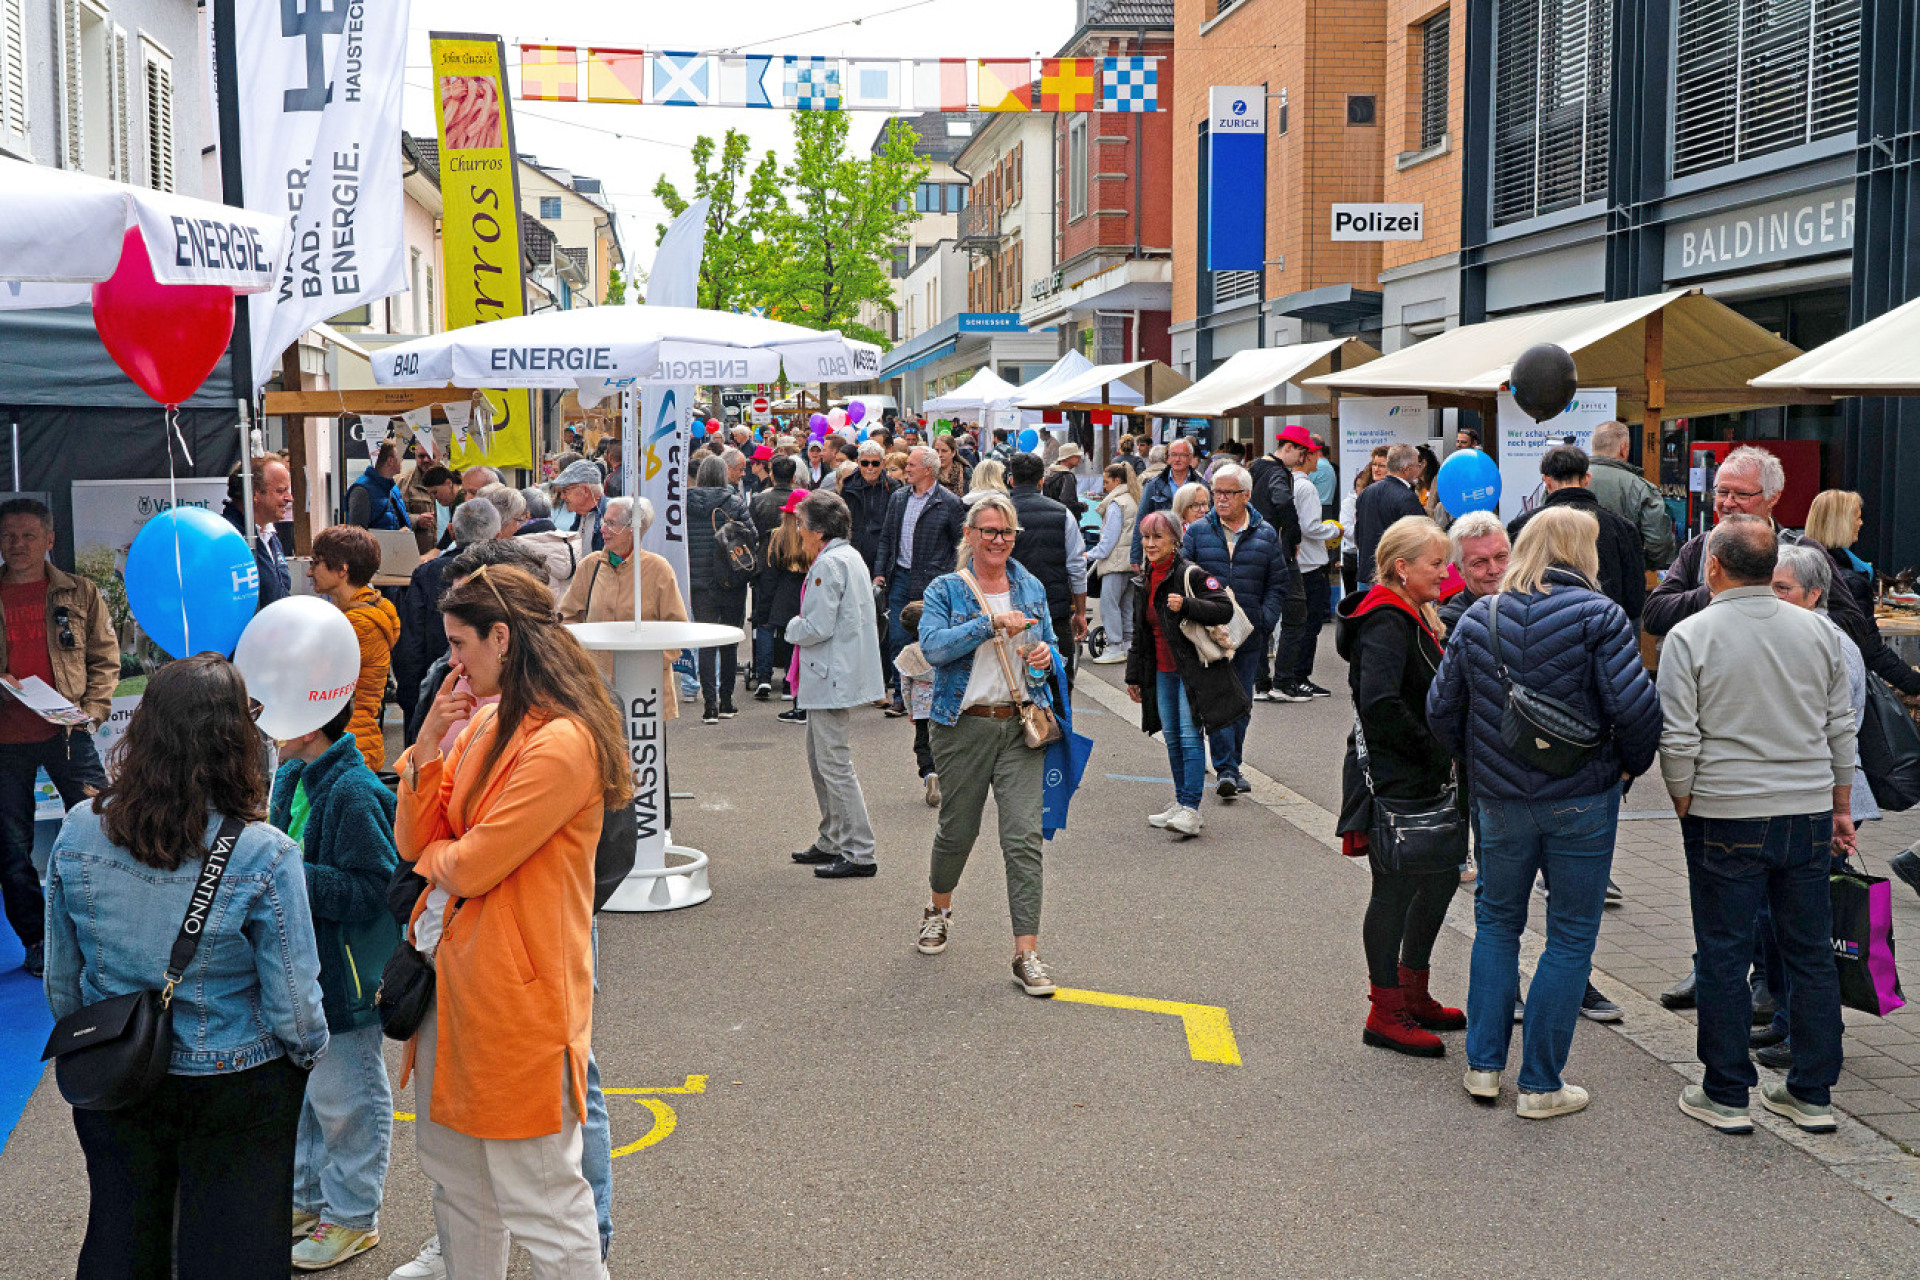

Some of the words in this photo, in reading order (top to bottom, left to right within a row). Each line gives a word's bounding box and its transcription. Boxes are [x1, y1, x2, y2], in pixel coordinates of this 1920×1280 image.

[346, 0, 363, 102] HAUSTEC
[441, 51, 460, 66] John
[1219, 119, 1259, 128] ZURICH
[450, 155, 503, 172] Churros
[170, 215, 273, 273] ENERGIE.
[277, 158, 312, 304] WER.
[331, 143, 360, 295] ENERGIE.
[1335, 211, 1419, 232] Polizei
[1682, 197, 1855, 268] BALDINGER
[301, 221, 322, 298] BAD.
[393, 353, 419, 376] BAD.
[491, 347, 618, 370] ENERGIE.
[666, 431, 682, 542] roma.
[632, 688, 657, 840] WASSER.
[185, 836, 236, 934] VALENTINO
